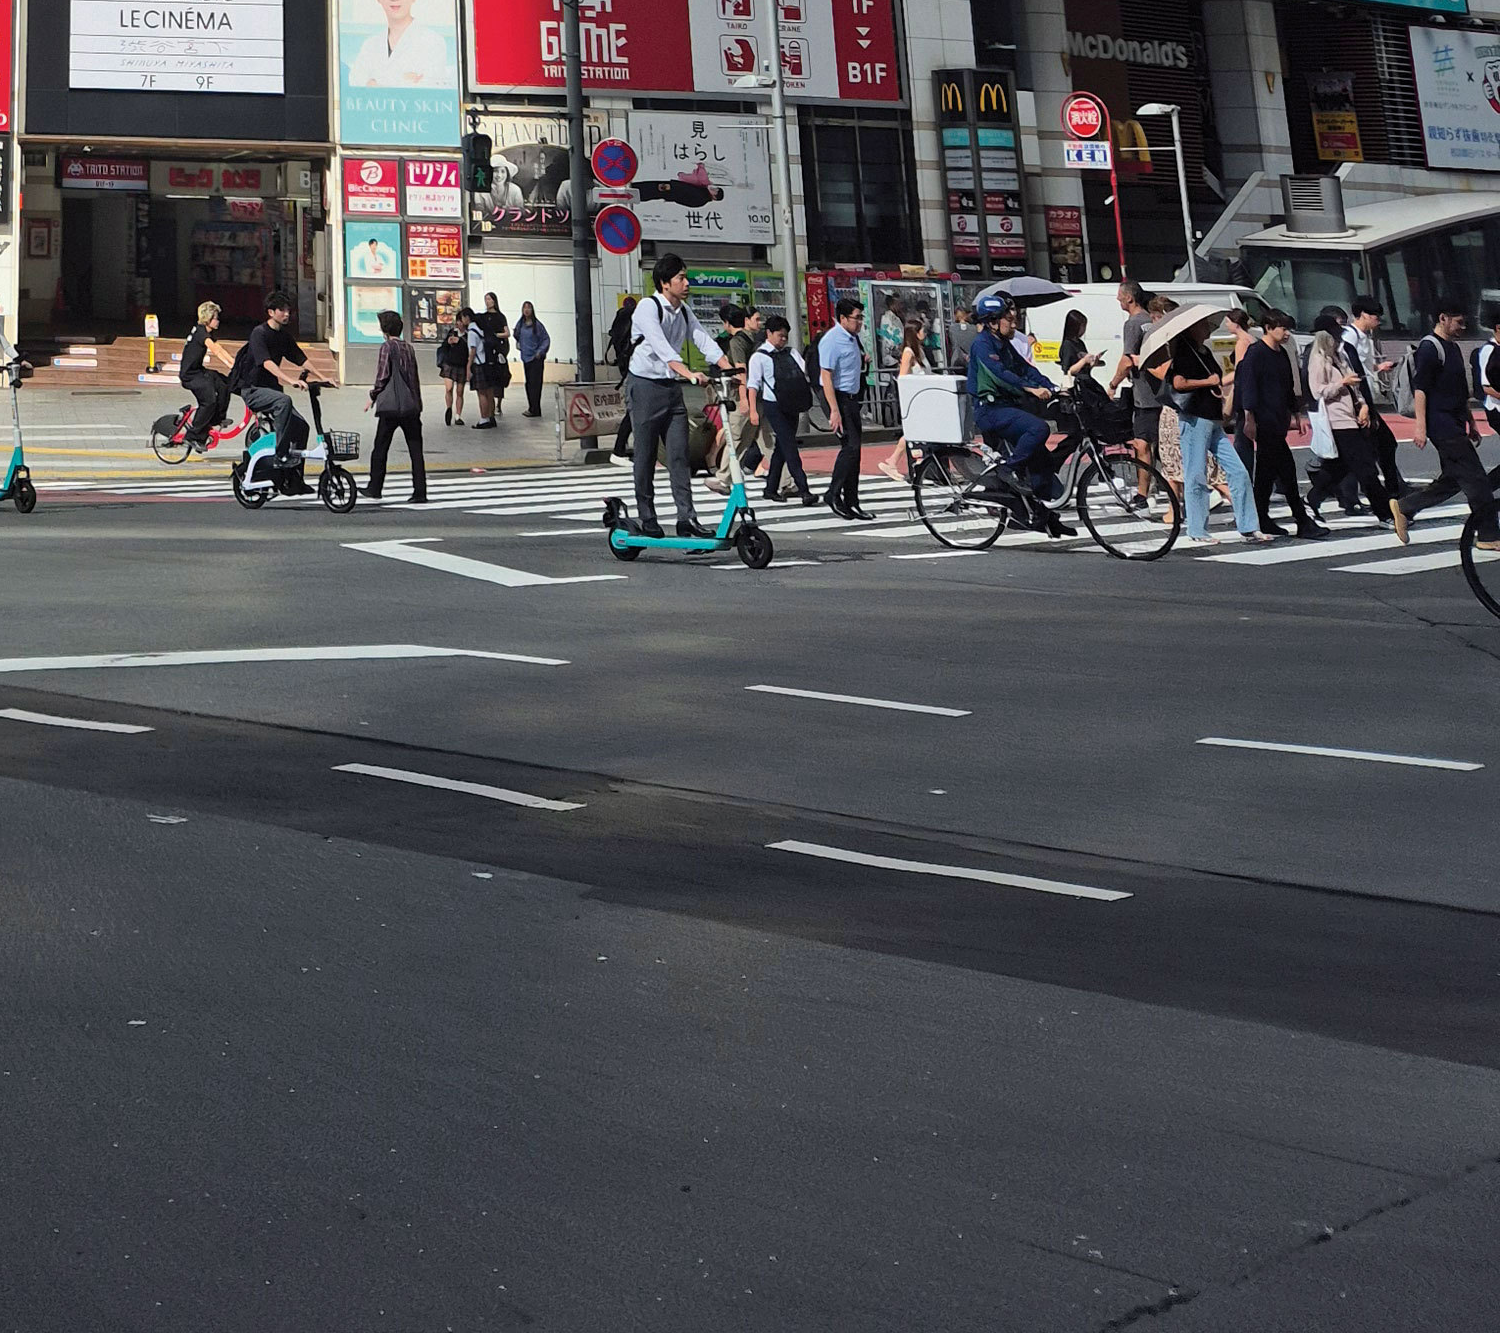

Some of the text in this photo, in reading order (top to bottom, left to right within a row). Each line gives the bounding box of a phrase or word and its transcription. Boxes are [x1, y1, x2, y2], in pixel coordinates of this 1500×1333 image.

[539, 20, 629, 65] GME
[1066, 30, 1188, 71] McDonald's
[175, 60, 234, 69] MIYASHITA
[580, 65, 630, 81] STATION
[847, 61, 888, 85] B1F
[140, 74, 214, 89] 7F 9F
[345, 97, 454, 115] BEAUTY SKIN
[371, 119, 430, 134] CLINIC
[1069, 110, 1099, 127] 消火栓
[690, 120, 708, 140] 見
[673, 143, 726, 162] はらし
[1067, 149, 1108, 163] KEN
[84, 163, 144, 176] TAITO STATION
[407, 162, 459, 187] ゼクシィ
[685, 211, 724, 231] 世代
[748, 214, 771, 224] 10.10
[439, 244, 459, 257] OK
